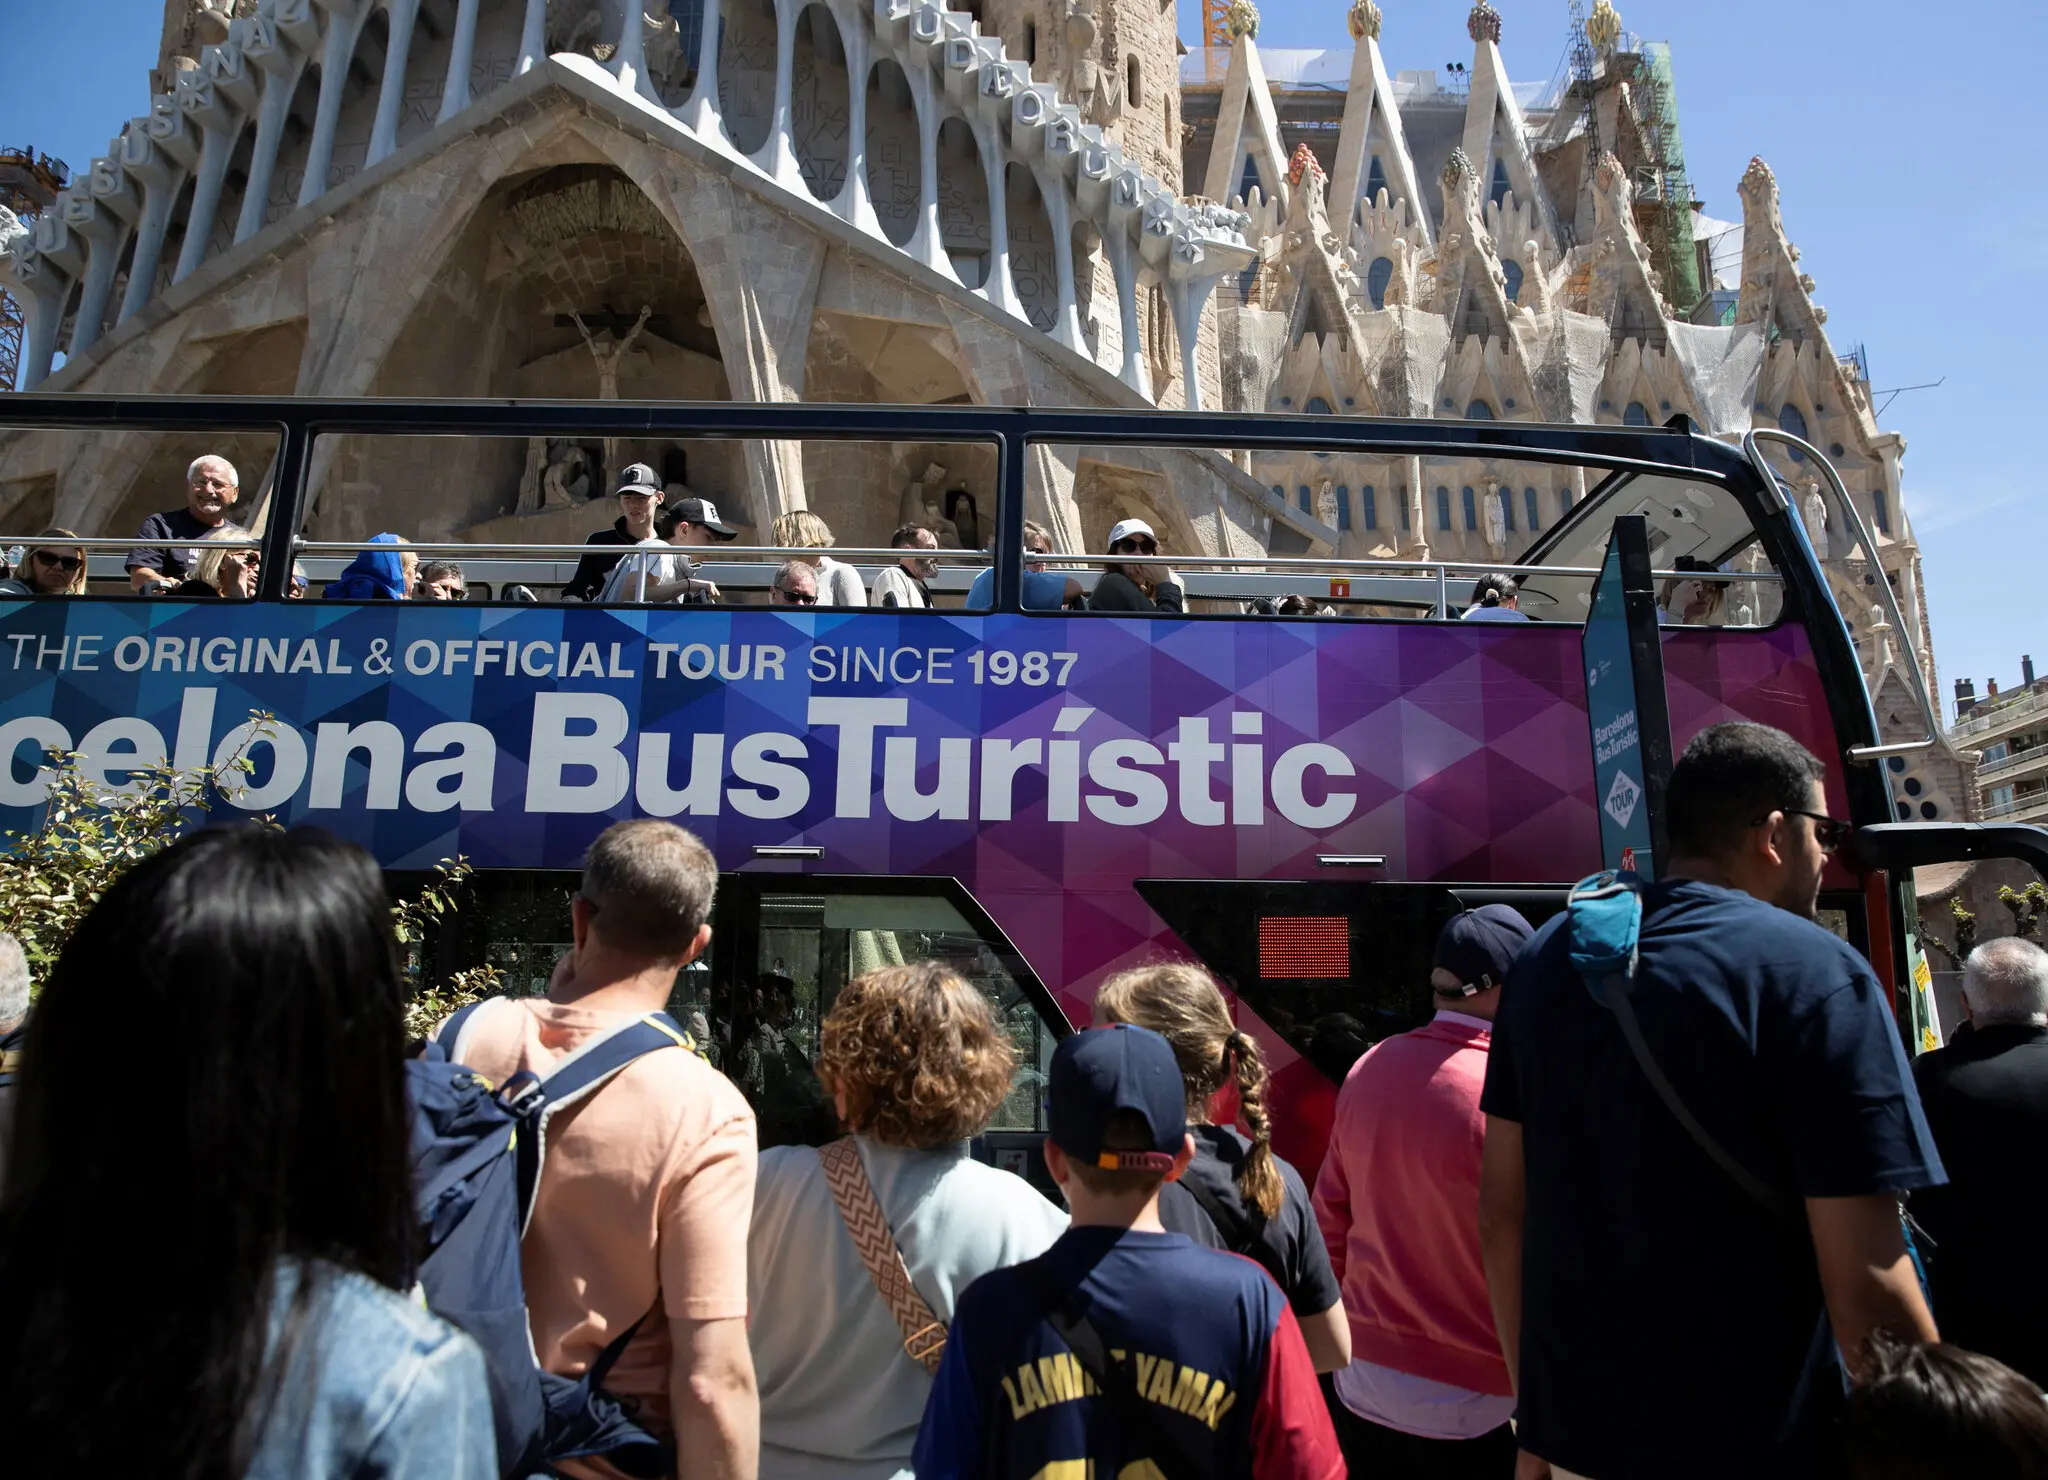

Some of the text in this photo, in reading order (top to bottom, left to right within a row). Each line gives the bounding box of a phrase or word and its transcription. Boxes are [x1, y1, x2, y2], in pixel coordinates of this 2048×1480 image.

[7, 634, 1079, 686] THE ORIGINAL & OFFICIAL TOUR SINCE 1987
[1594, 709, 1635, 746] Barcelona
[0, 687, 497, 813] celona
[1610, 787, 1634, 814] TOUR
